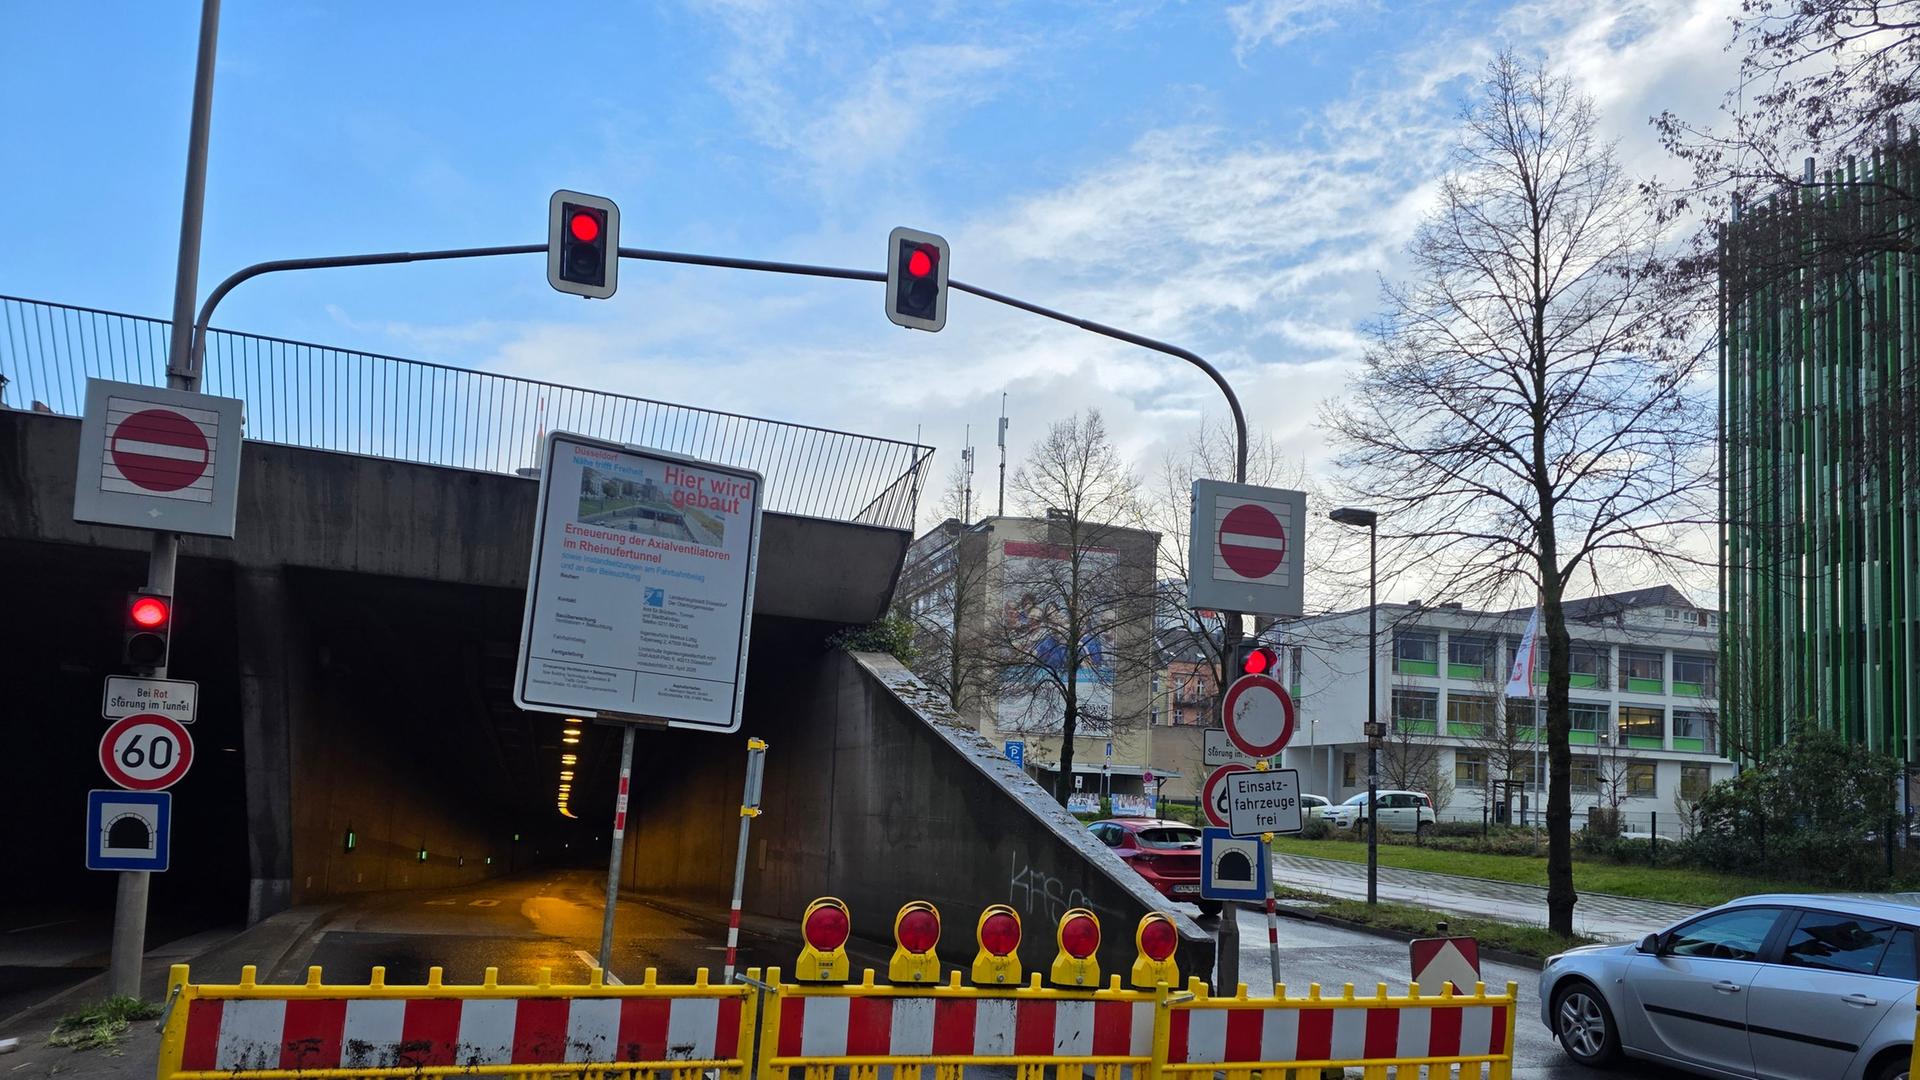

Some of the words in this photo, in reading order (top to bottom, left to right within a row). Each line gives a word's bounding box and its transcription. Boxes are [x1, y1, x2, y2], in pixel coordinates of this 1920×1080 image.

[574, 446, 618, 461] Düsseldorf
[664, 465, 705, 490] Hier
[710, 478, 751, 500] wird
[672, 488, 740, 515] gebaut
[565, 523, 626, 545] Erneuerung
[629, 534, 646, 546] der
[647, 537, 730, 561] Axialventilatoren
[563, 537, 577, 549] im
[579, 540, 662, 563] Rheinufertunnel
[137, 687, 151, 698] Bei
[153, 688, 168, 699] Rot
[111, 696, 146, 711] Störung
[148, 700, 159, 710] im
[162, 701, 189, 711] Tunnel
[121, 734, 173, 770] 60
[1238, 780, 1288, 793] Einsatz-
[1235, 797, 1295, 811] fahrzeuge
[1256, 812, 1277, 826] frei
